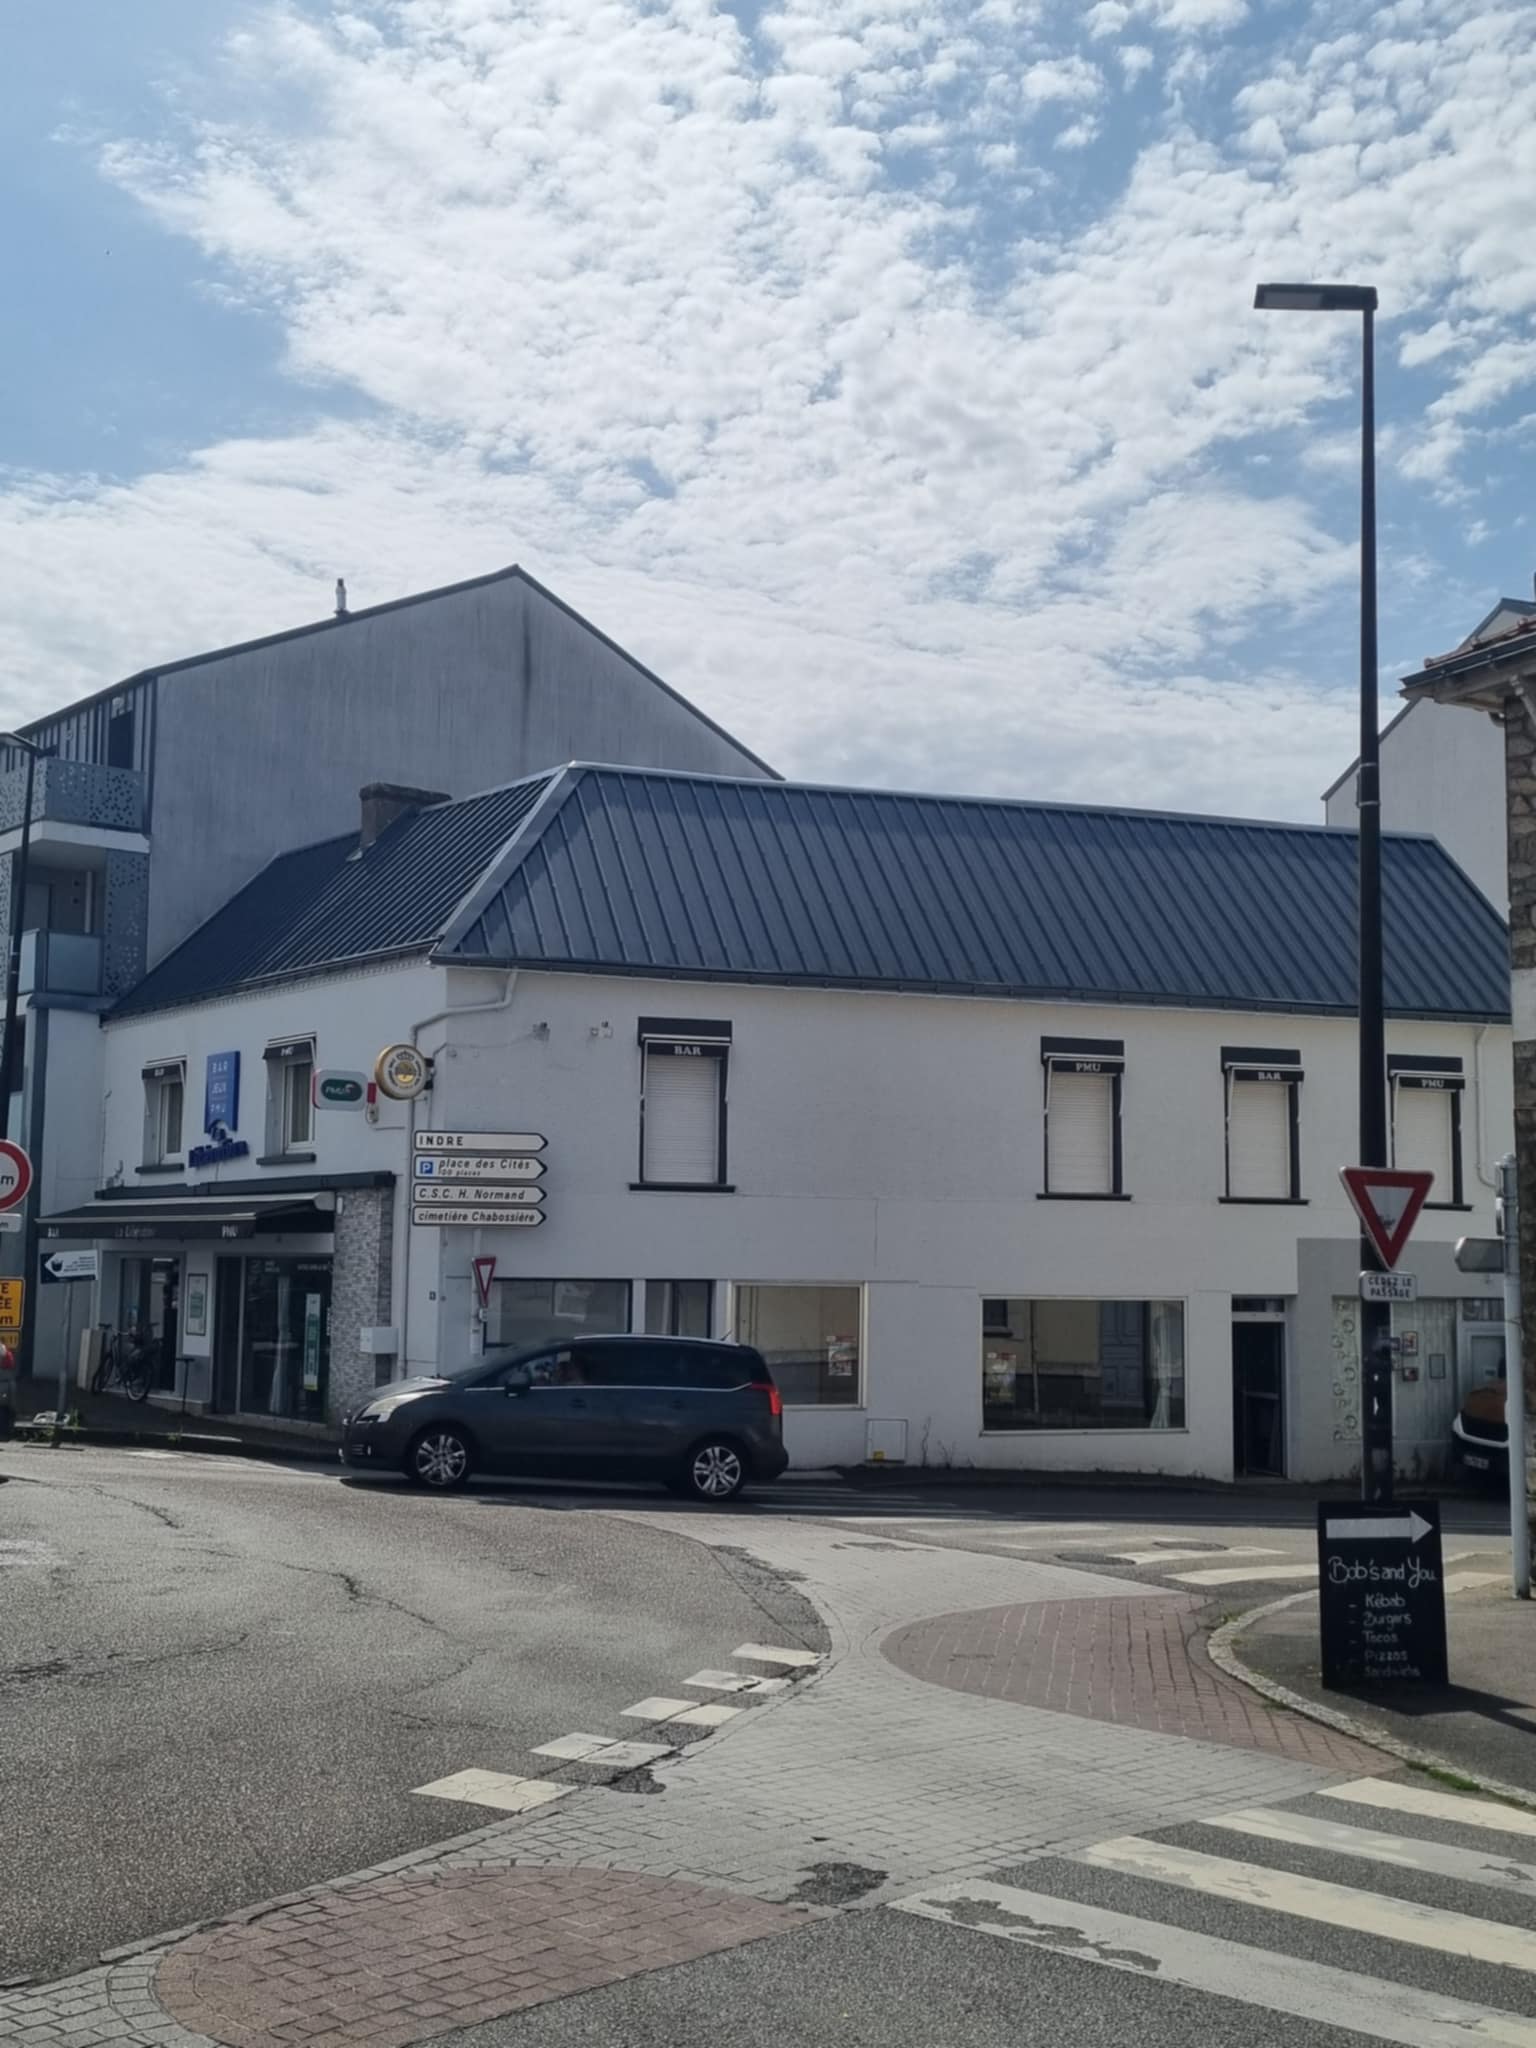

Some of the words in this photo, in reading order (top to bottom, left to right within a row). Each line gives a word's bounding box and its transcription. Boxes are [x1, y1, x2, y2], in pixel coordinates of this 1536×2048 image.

[673, 1045, 702, 1057] BAR
[1075, 1062, 1102, 1073] PMU
[1257, 1071, 1283, 1081] BAR
[1421, 1079, 1445, 1089] PMU
[419, 1135, 464, 1147] INDRE
[438, 1159, 470, 1170] place
[475, 1159, 495, 1169] des
[500, 1159, 530, 1170] Cités
[419, 1188, 454, 1199] C.S.C.
[458, 1189, 470, 1199] H.
[474, 1189, 526, 1201] Normand
[471, 1211, 535, 1223] Chabossière
[1402, 1277, 1412, 1287] LE
[1370, 1286, 1410, 1299] PASSAGE
[1328, 1556, 1380, 1584] Bob's
[1381, 1562, 1405, 1581] and
[1407, 1556, 1437, 1589] You
